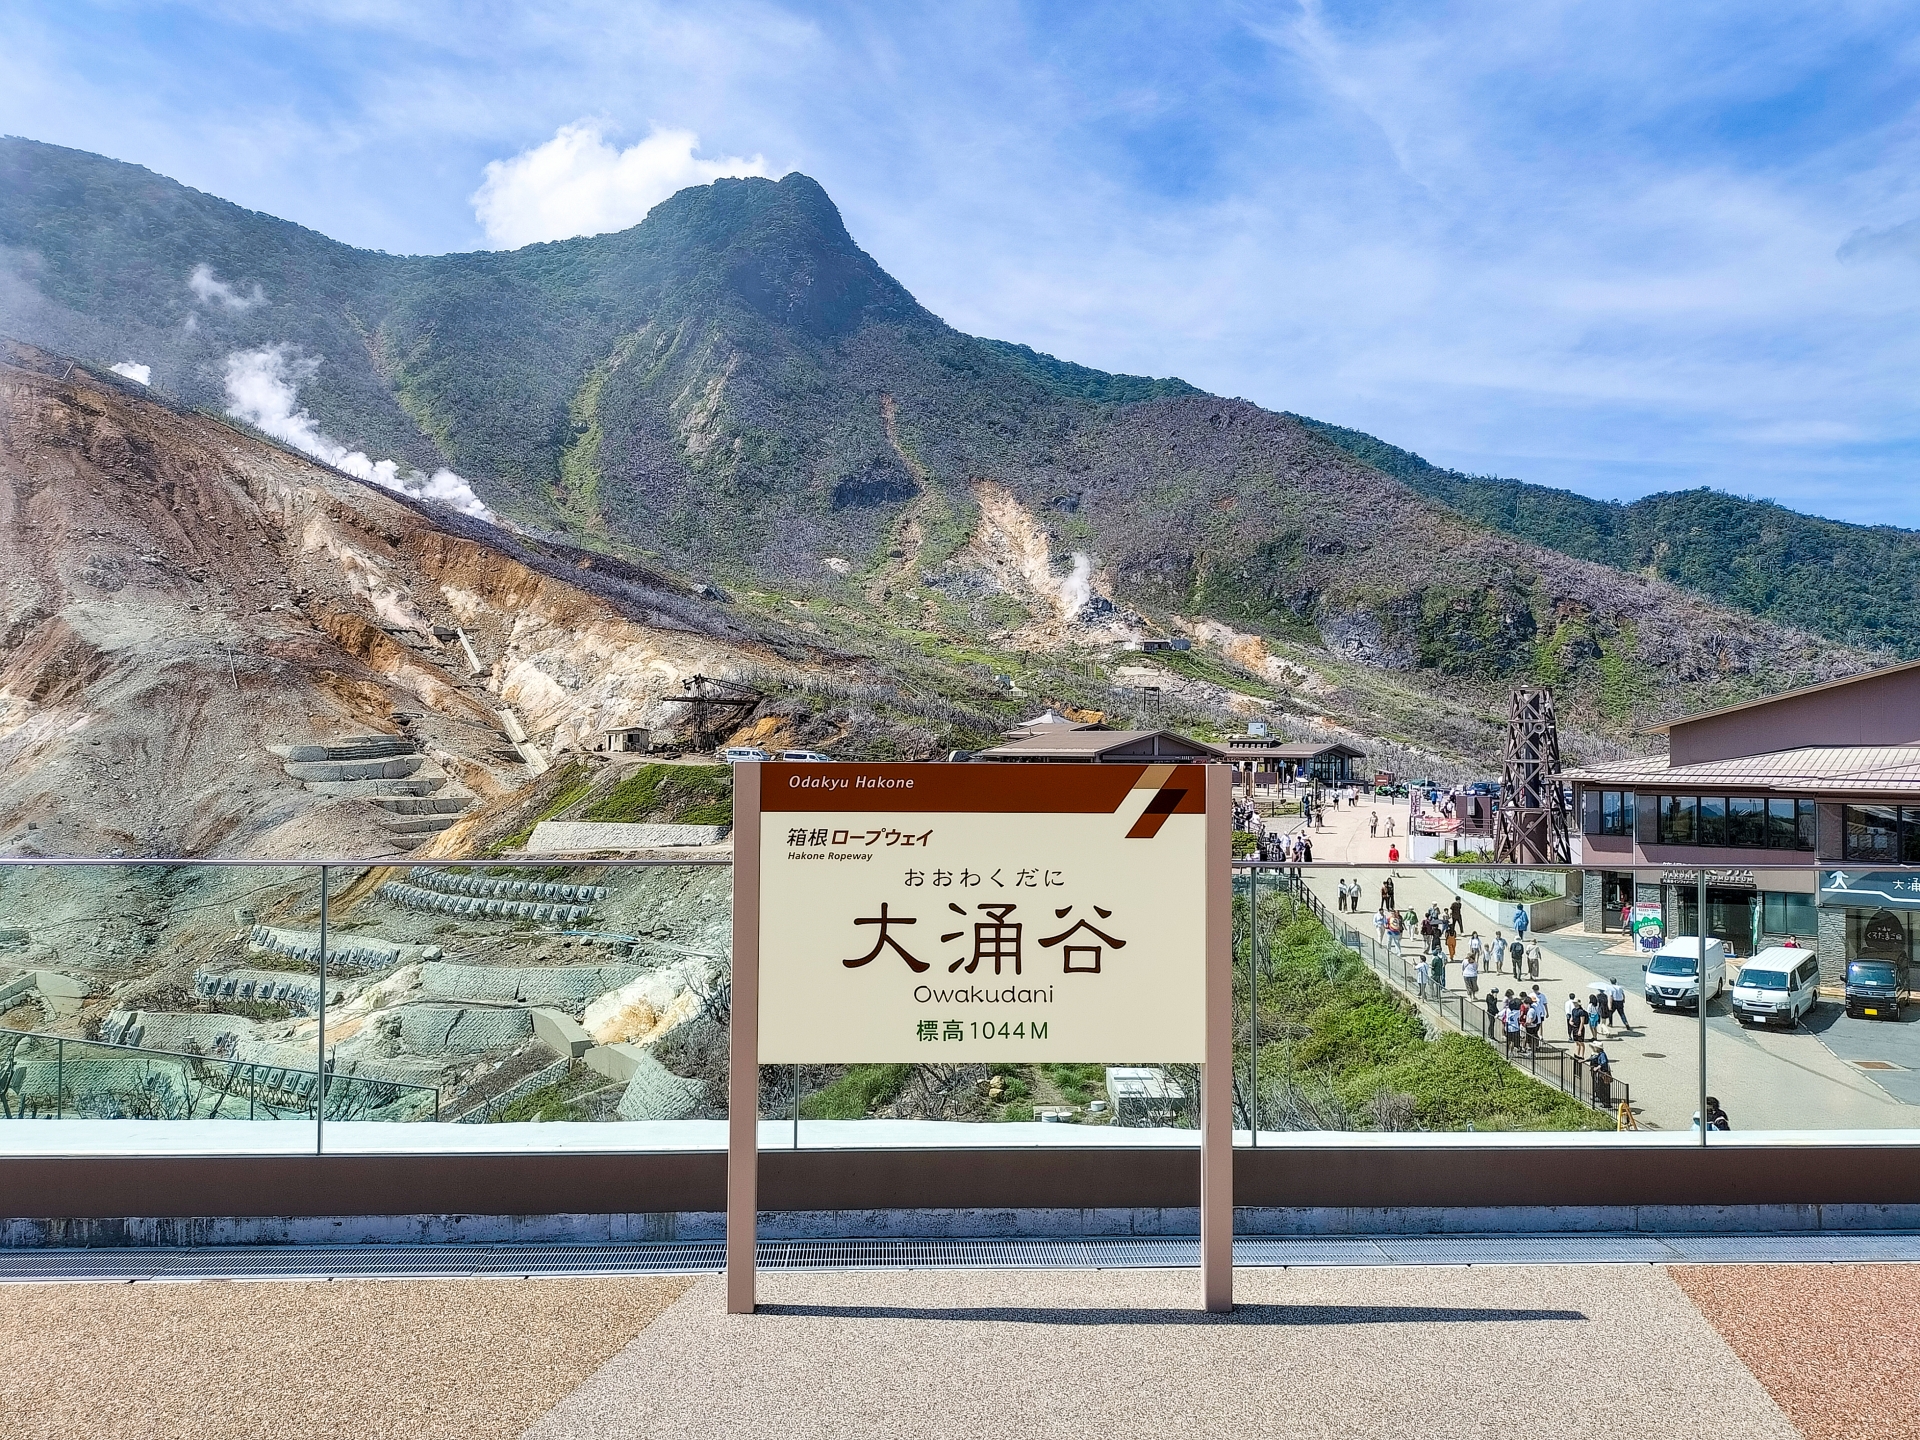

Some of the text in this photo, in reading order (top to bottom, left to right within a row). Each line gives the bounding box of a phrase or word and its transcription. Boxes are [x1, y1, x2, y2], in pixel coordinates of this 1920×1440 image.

[789, 775, 914, 791] Odakyu Hakone
[786, 827, 934, 847] 箱根ロープウェイ
[787, 851, 873, 862] Hakone Ropeway
[904, 867, 1066, 888] おおわくだに
[842, 901, 1127, 976] 大涌谷
[913, 984, 1054, 1003] Owakudani
[916, 1018, 1049, 1042] 標高1044M
